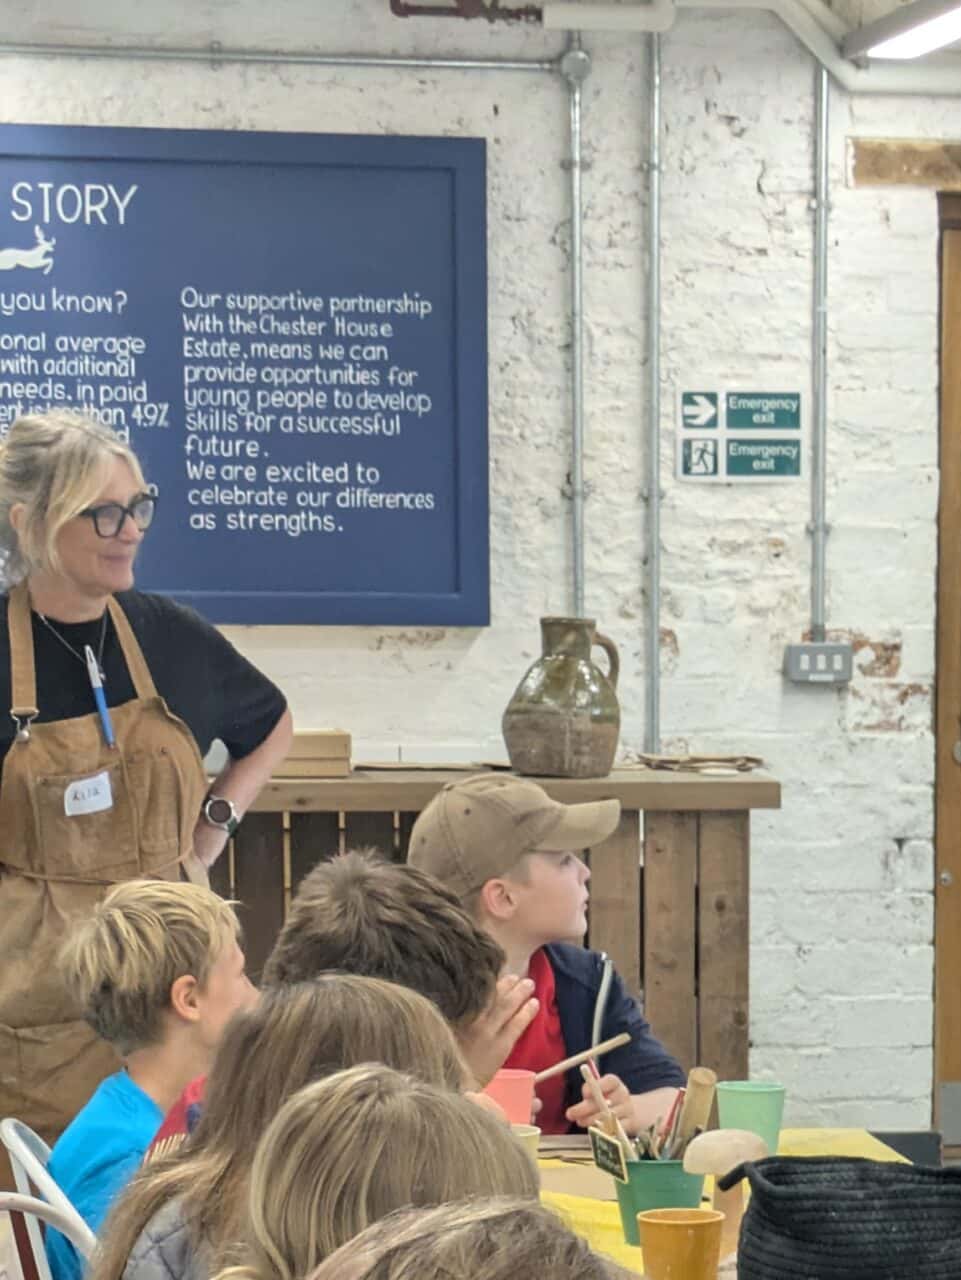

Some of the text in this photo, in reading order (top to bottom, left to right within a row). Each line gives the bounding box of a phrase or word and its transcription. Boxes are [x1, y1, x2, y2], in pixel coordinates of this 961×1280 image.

[11, 182, 139, 226] STORY
[0, 287, 128, 316] you know?
[181, 286, 432, 319] Our supportive partnership
[183, 313, 393, 338] With the Chester House
[55, 335, 146, 363] average
[250, 342, 313, 361] means
[319, 344, 345, 361] we
[350, 345, 389, 361] can
[0, 353, 136, 378] with additional
[184, 361, 418, 387] provide opportunities for
[77, 378, 95, 401] in
[99, 379, 148, 407] paid
[184, 387, 432, 417] young people to develop
[728, 395, 799, 413] Emergency
[185, 410, 401, 436] skills for a successful
[751, 412, 776, 424] exit
[185, 434, 269, 458] future.
[728, 442, 799, 460] Emergency
[186, 460, 380, 485] We are excited to
[751, 458, 776, 471] exit
[187, 485, 435, 510] celebrate our differences
[189, 510, 344, 537] as strengths.
